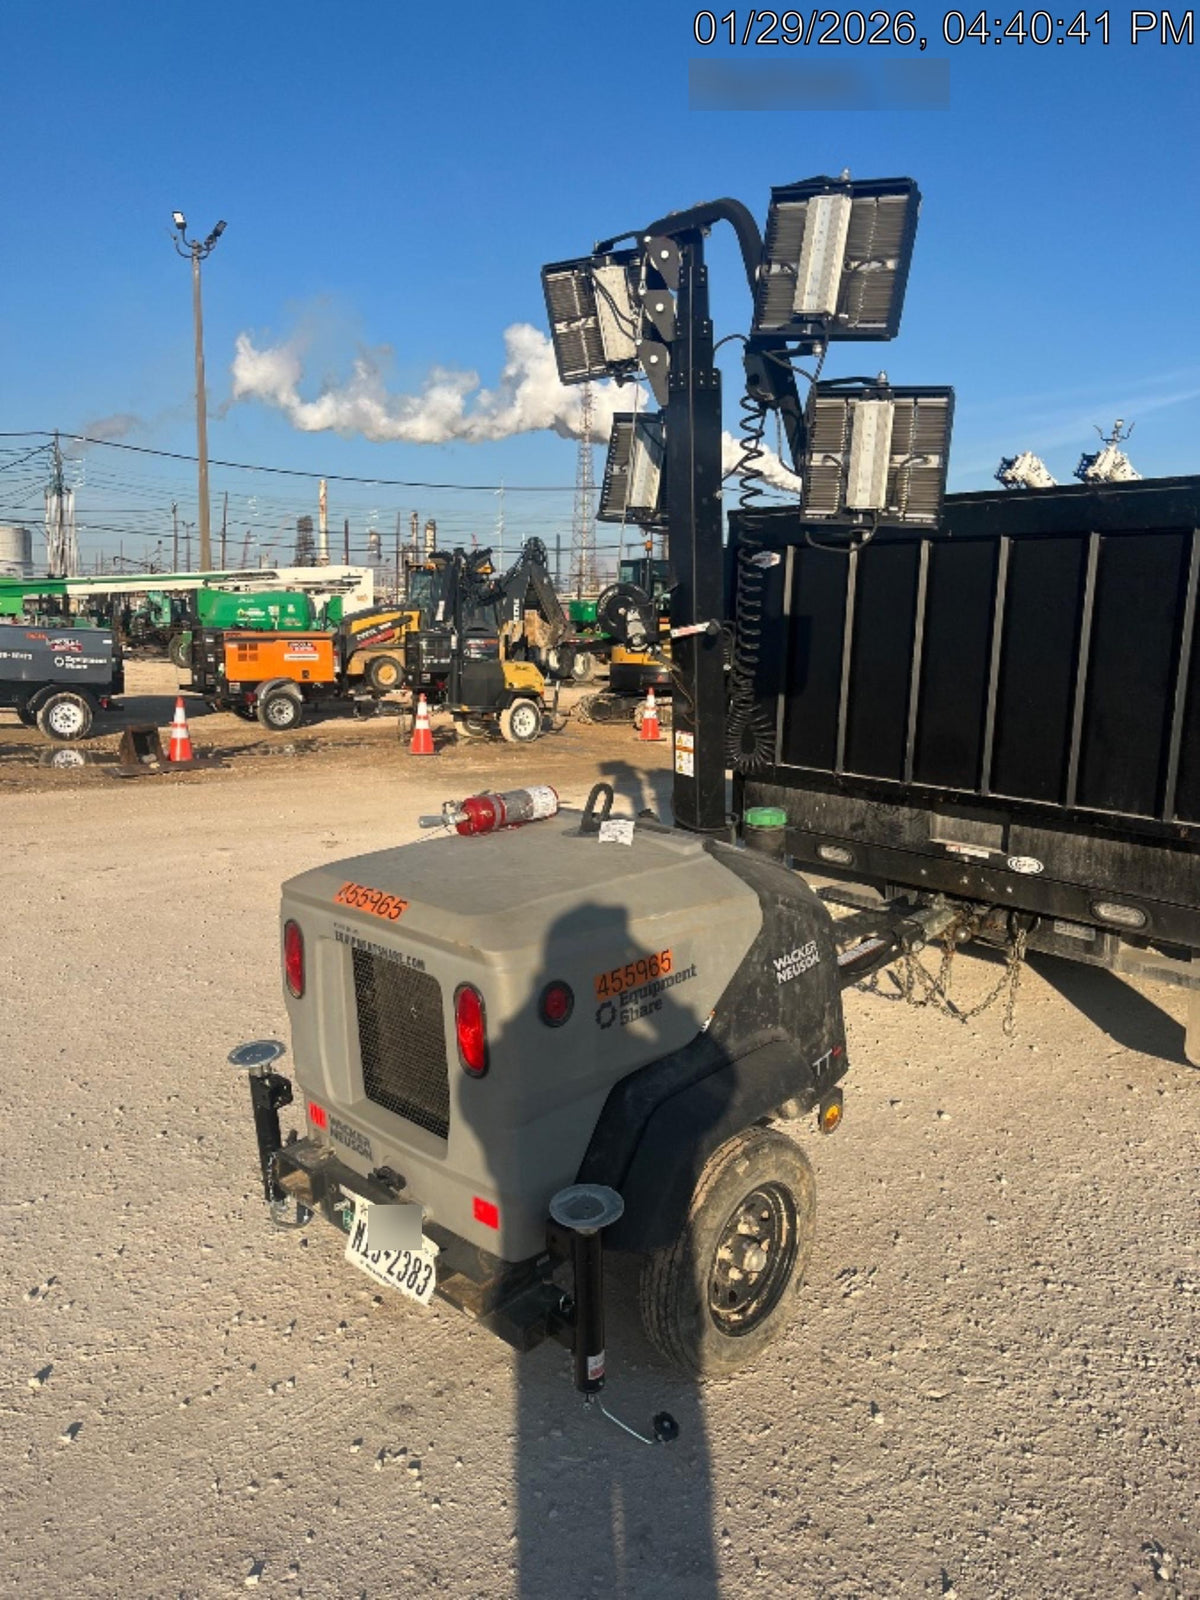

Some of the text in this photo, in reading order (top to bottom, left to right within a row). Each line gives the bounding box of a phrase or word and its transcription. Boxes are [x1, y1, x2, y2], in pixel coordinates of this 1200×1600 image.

[597, 948, 672, 996] 455965
[773, 940, 817, 971] WACKER
[776, 951, 820, 984] NEUSON
[619, 963, 697, 1007] Equipment
[620, 999, 662, 1026] Share
